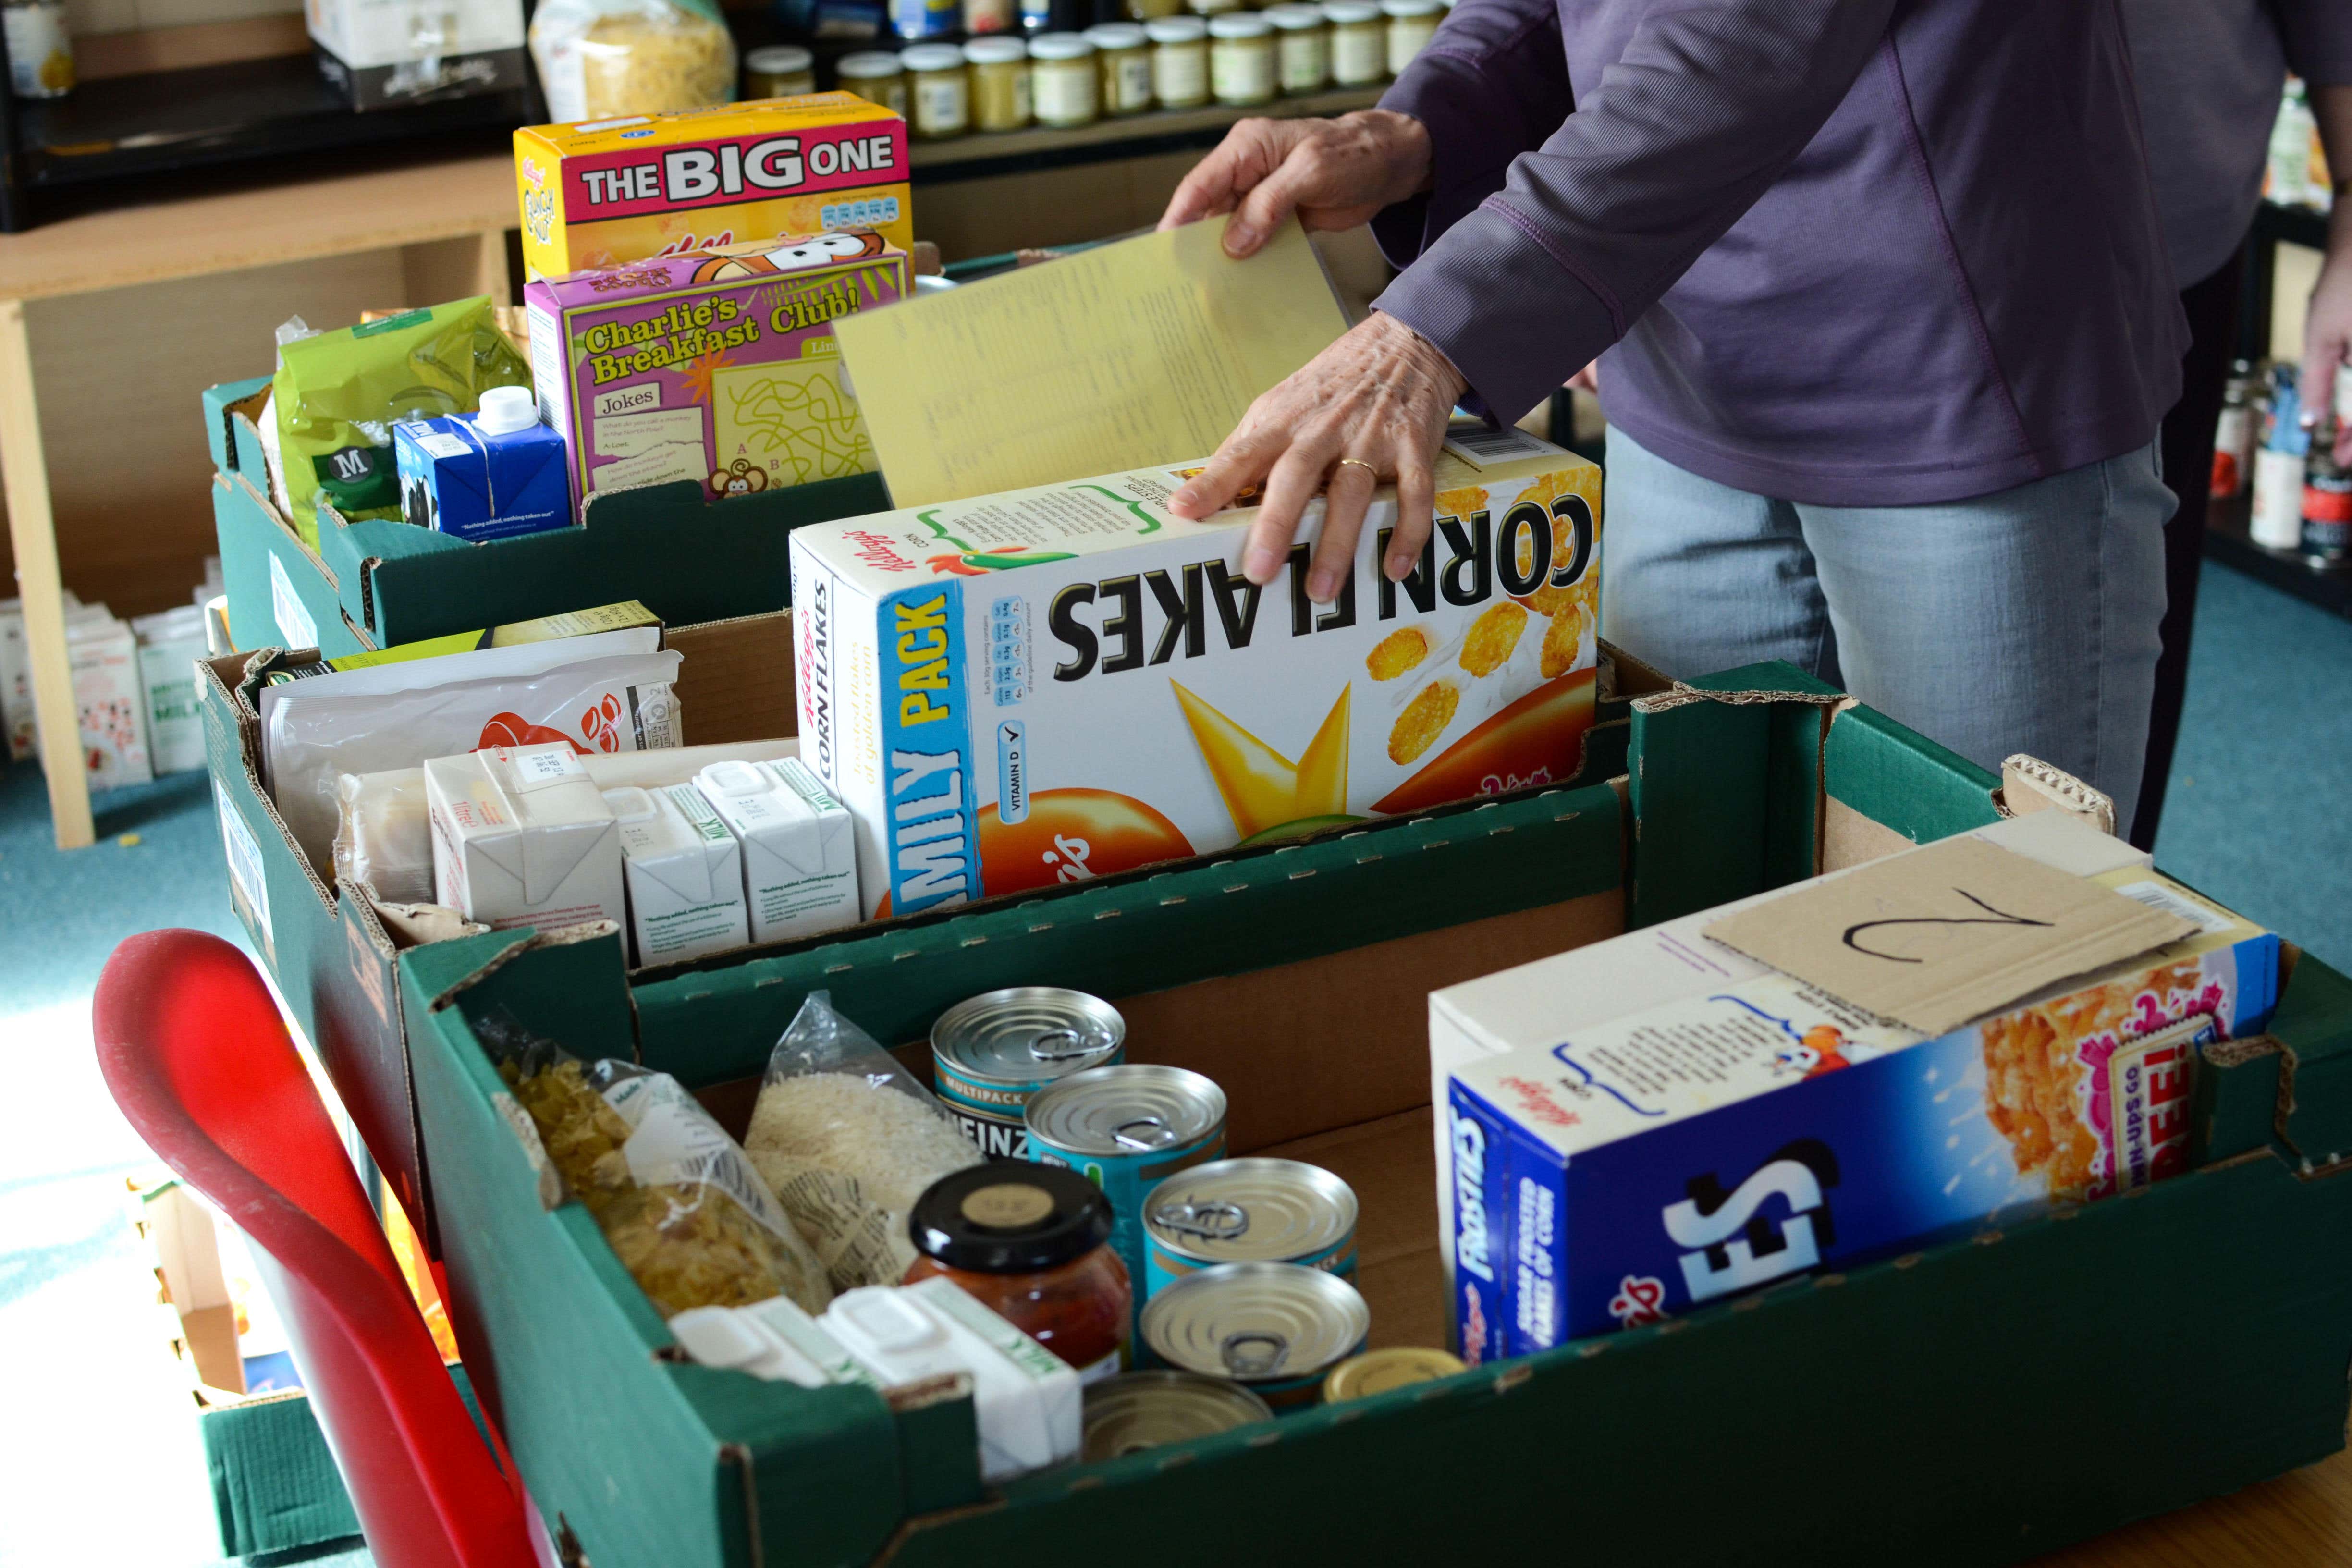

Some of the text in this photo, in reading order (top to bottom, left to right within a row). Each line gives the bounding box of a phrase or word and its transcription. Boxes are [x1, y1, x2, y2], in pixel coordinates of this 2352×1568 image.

[581, 135, 895, 204] THE BIG ONE
[585, 296, 739, 355] Charlie's
[590, 315, 760, 386] Breakfast
[770, 287, 861, 335] Club!
[603, 391, 654, 415] Jokes
[334, 449, 369, 479] M
[737, 443, 747, 454] A
[770, 459, 780, 470] B
[1124, 483, 1153, 498] STEPS
[843, 530, 917, 572] Kellogg's
[903, 533, 930, 548] CORN
[1378, 494, 1593, 621] CORN
[800, 606, 815, 730] Kellogg's
[815, 578, 831, 781] CORN FLAKES
[863, 645, 878, 785] of golden corn
[891, 592, 968, 907] MILY PACK
[808, 791, 842, 811] MILK
[1010, 751, 1021, 811] VITAMIN D
[699, 818, 732, 840] MILK
[1842, 887, 2056, 965] 2
[946, 1075, 1023, 1104] MULTIPACK
[2124, 1066, 2139, 1094] GO
[1448, 1103, 1494, 1284] FROSTIES
